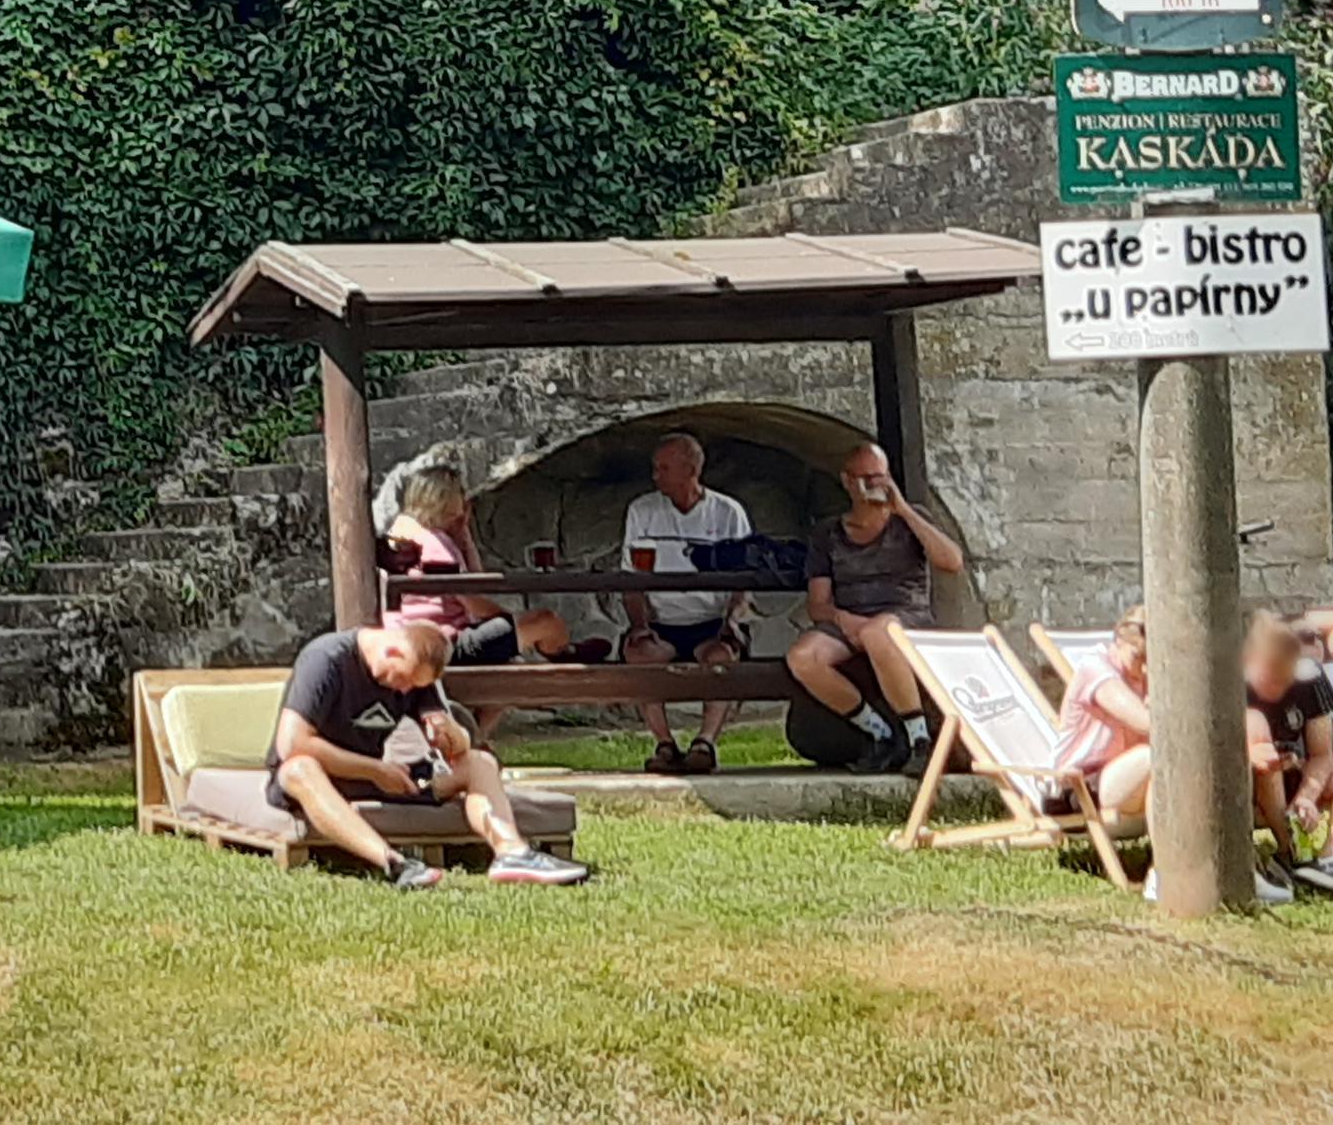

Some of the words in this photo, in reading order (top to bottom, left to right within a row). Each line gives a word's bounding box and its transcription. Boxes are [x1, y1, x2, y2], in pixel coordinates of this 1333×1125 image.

[1111, 69, 1241, 97] BERNARD
[1075, 113, 1156, 131] PENZION
[1167, 112, 1282, 130] RESTAURACE
[1075, 127, 1287, 171] KASKÁDA
[1185, 224, 1307, 266] bistro
